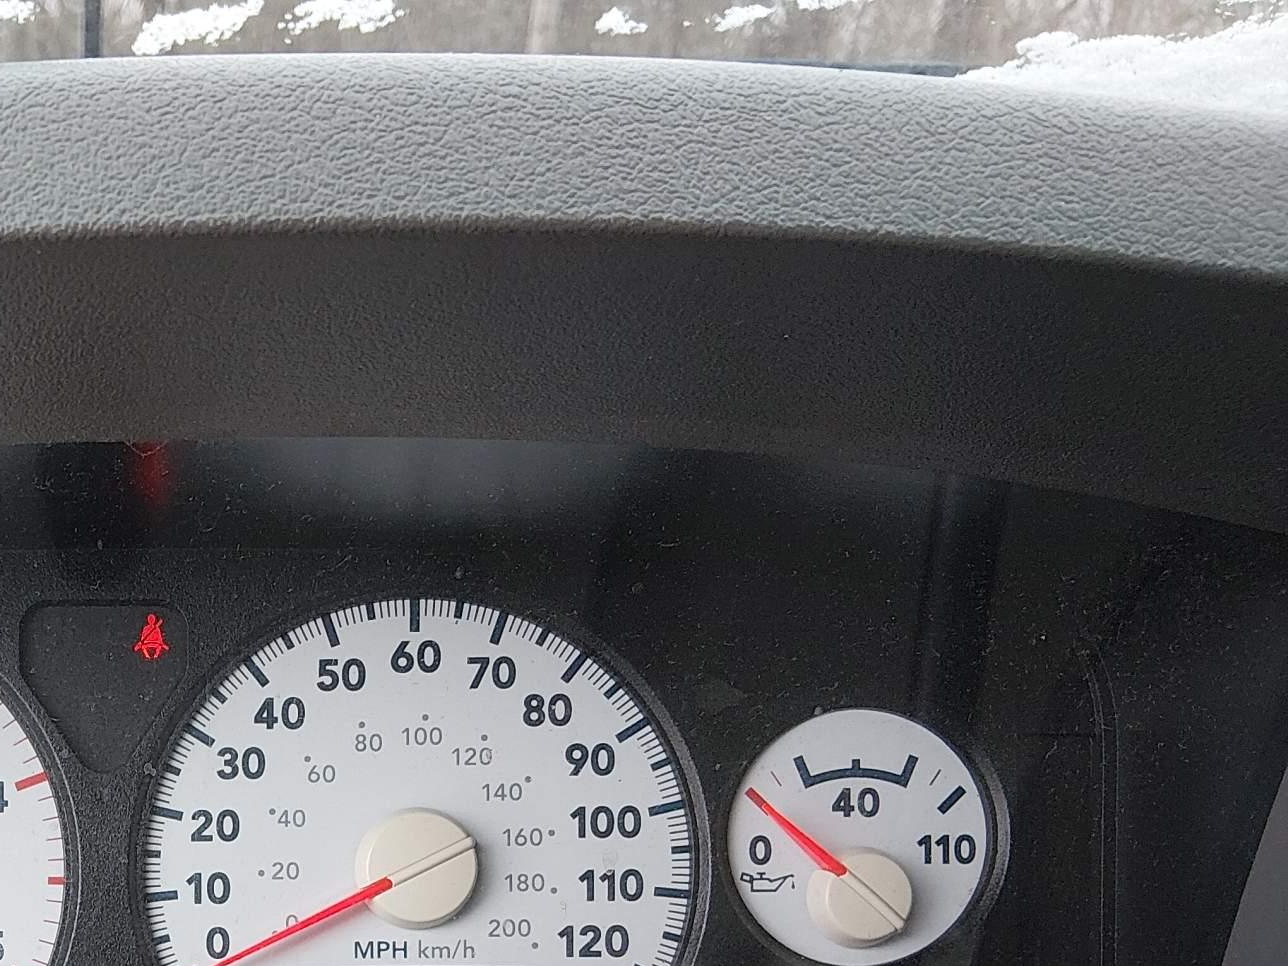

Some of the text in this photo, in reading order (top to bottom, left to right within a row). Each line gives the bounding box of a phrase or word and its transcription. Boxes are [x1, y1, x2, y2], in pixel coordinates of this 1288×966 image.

[390, 639, 442, 674] 60
[466, 655, 517, 690] 70
[316, 657, 367, 692] 50
[253, 696, 306, 730] 40
[522, 693, 573, 728] 80
[354, 733, 383, 753] 80
[401, 726, 443, 746] 100
[216, 746, 266, 780] 30
[451, 747, 493, 767] 120
[565, 742, 616, 777] 90
[307, 764, 336, 784] 60
[481, 782, 523, 802] 140
[831, 787, 880, 818] 40
[190, 808, 240, 843] 20
[277, 809, 306, 828] 40
[569, 805, 642, 839] 100
[502, 827, 543, 847] 160
[748, 834, 772, 866] 0
[916, 833, 977, 865] 110
[271, 861, 300, 881] 20
[504, 873, 545, 893] 180
[578, 868, 644, 902] 110
[185, 871, 231, 905] 10
[205, 926, 230, 960] 0
[487, 918, 532, 938] 200
[557, 924, 630, 958] 120
[354, 938, 476, 960] MPH km/h
